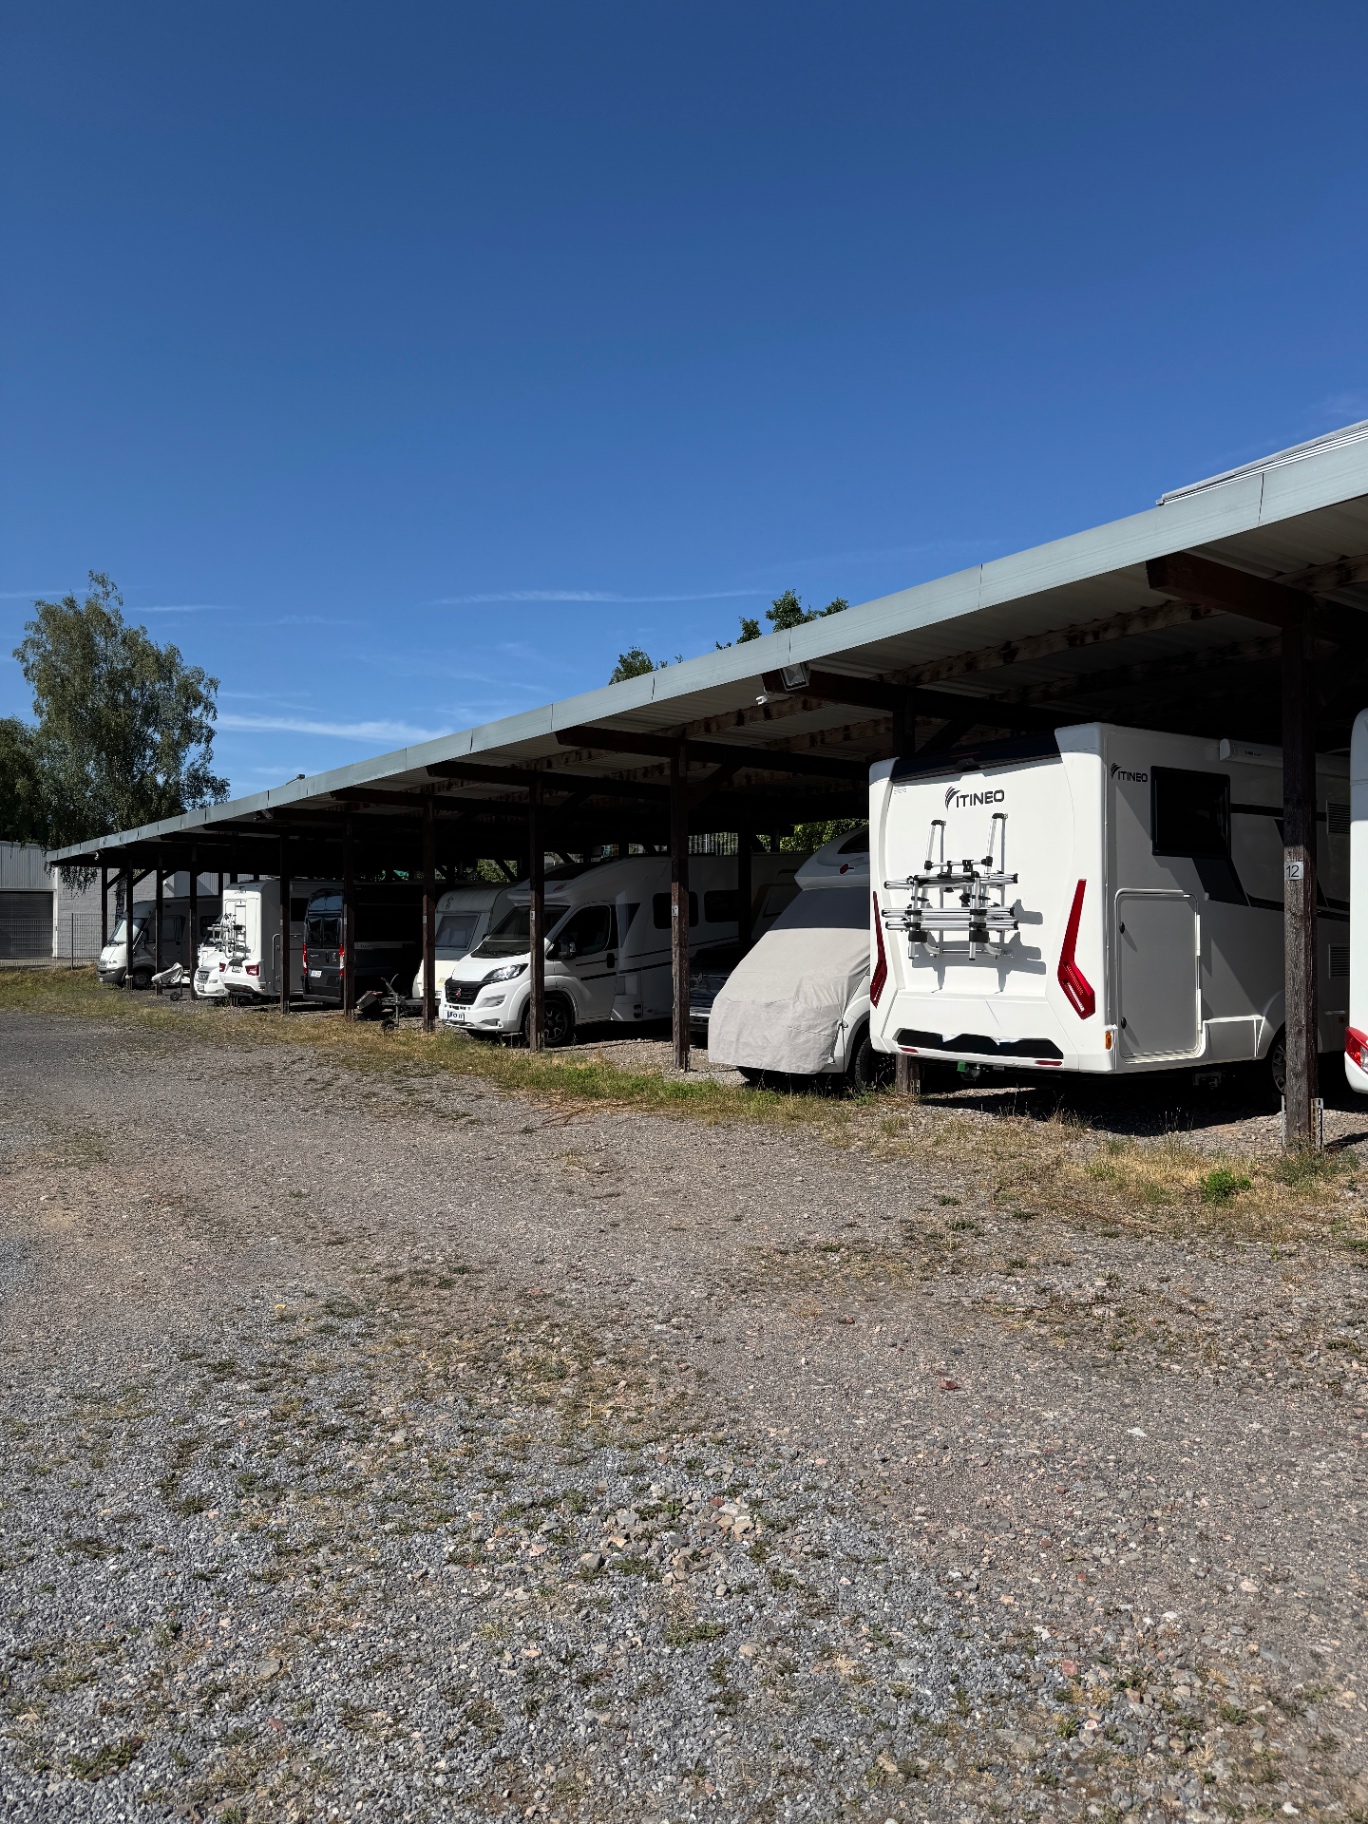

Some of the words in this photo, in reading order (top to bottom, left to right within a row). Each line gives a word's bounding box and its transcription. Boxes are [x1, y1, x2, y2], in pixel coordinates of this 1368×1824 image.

[1118, 770, 1148, 783] ITINEO
[956, 789, 1005, 808] ITINEO
[1286, 864, 1300, 878] 12
